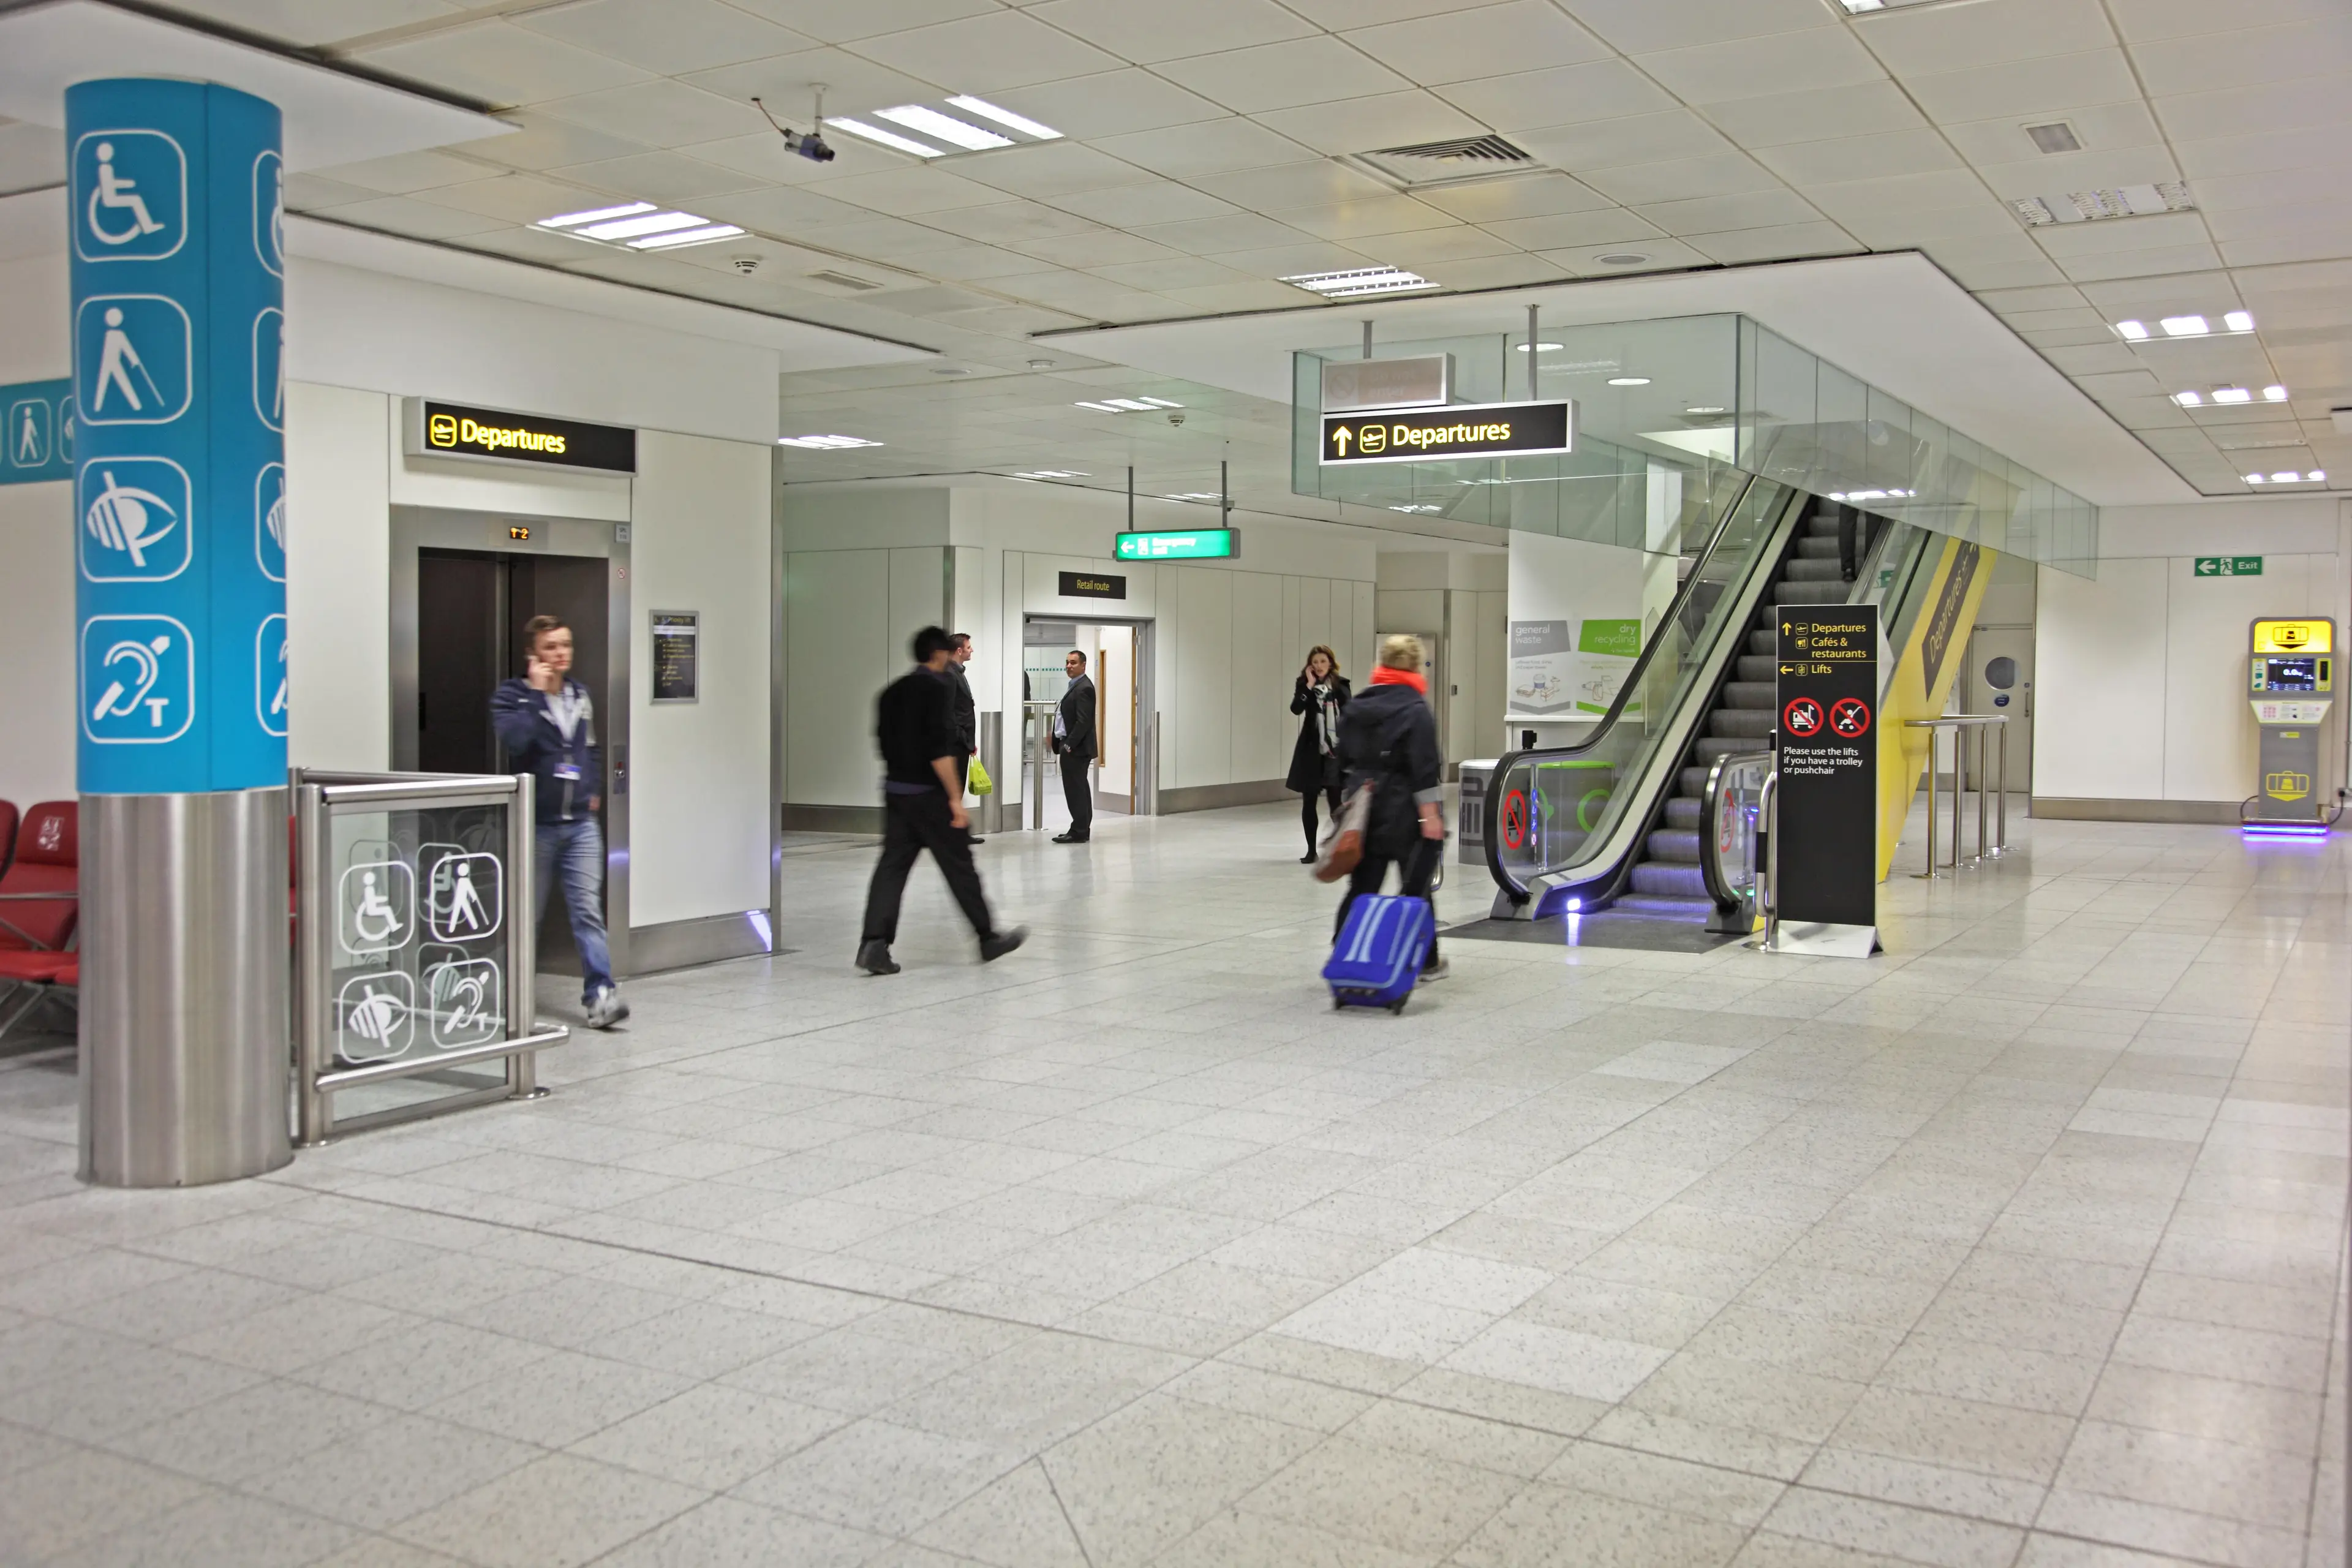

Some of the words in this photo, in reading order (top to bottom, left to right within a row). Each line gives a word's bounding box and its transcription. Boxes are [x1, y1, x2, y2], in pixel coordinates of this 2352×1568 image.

[461, 418, 566, 453] Departures
[1393, 423, 1511, 450] Departures
[1077, 579, 1093, 589] Retail
[1929, 570, 1962, 664] Departures
[1515, 624, 1550, 636] general
[1619, 624, 1637, 635] dry
[1812, 624, 1867, 634] Departures
[1595, 635, 1636, 646] recycling
[1811, 637, 1838, 647] Cafés
[1840, 637, 1848, 646] &
[1812, 650, 1867, 658] restaurants
[1812, 664, 1832, 673] Lifts
[145, 698, 169, 727] T
[1836, 758, 1863, 767] trolley
[1794, 766, 1835, 775] pushchair
